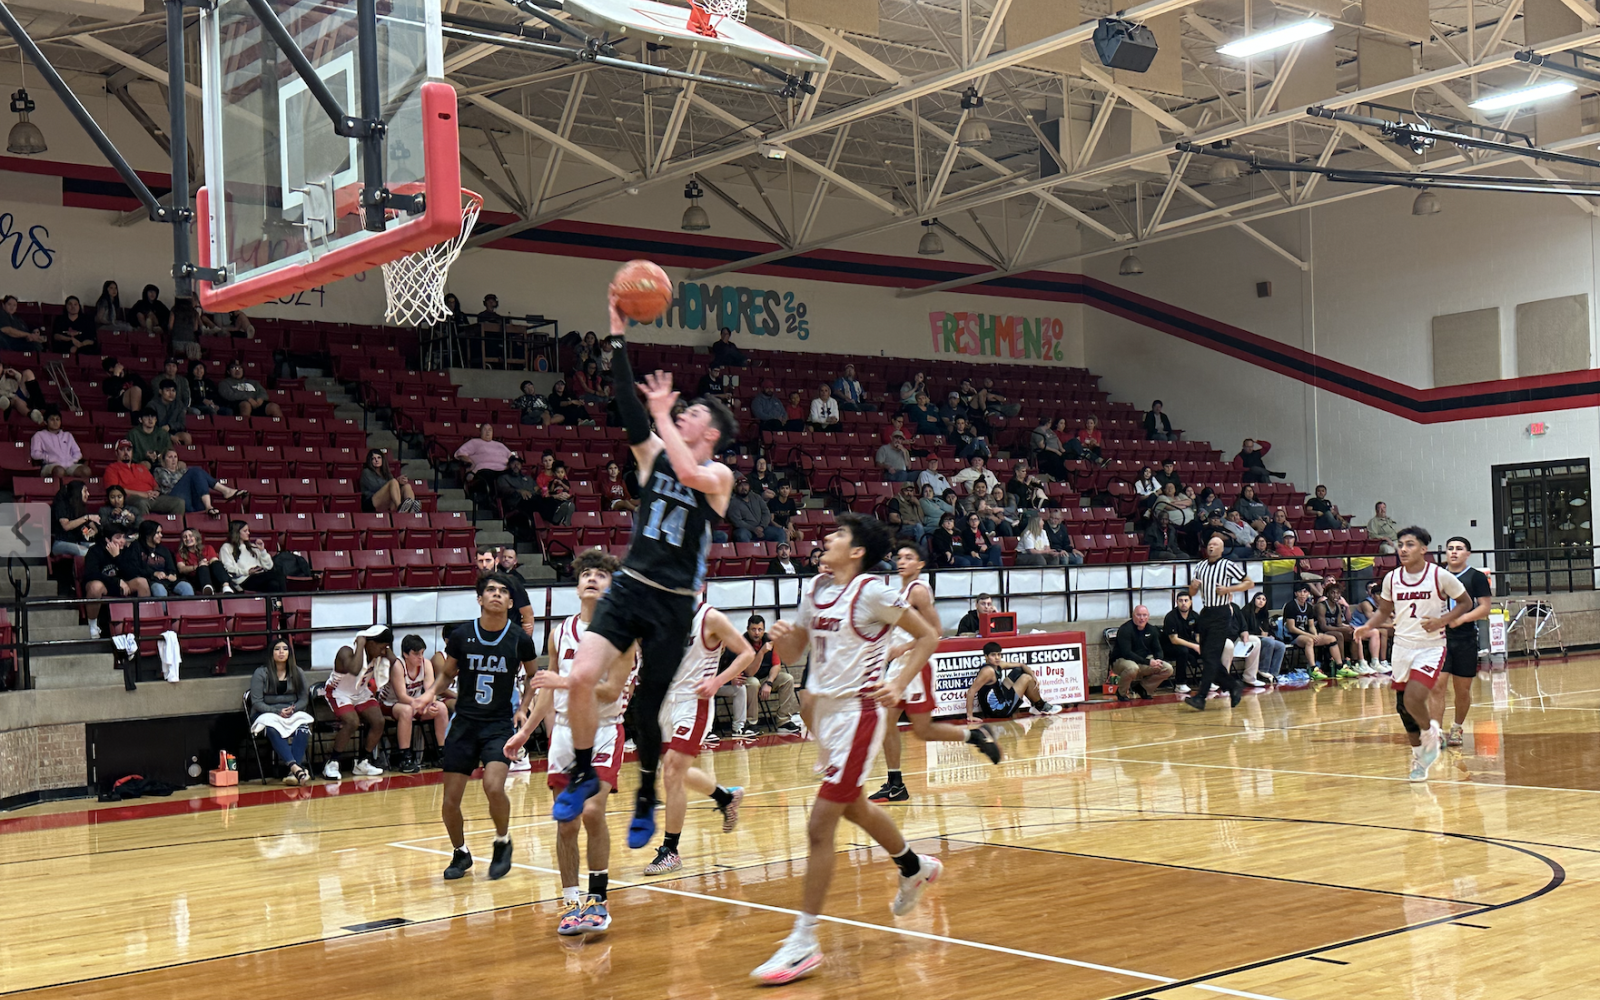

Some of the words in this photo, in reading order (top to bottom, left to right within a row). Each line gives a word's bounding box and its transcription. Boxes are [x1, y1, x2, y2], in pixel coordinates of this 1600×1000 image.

[664, 281, 781, 337] HOMORES
[929, 311, 1042, 360] FRESHMEN
[642, 498, 689, 548] 14
[1409, 602, 1417, 619] 2
[466, 653, 508, 673] TLCA
[1031, 649, 1075, 663] SCHOOL
[1046, 665, 1065, 678] Drug
[475, 673, 495, 705] 5
[935, 677, 976, 691] KRUN-14
